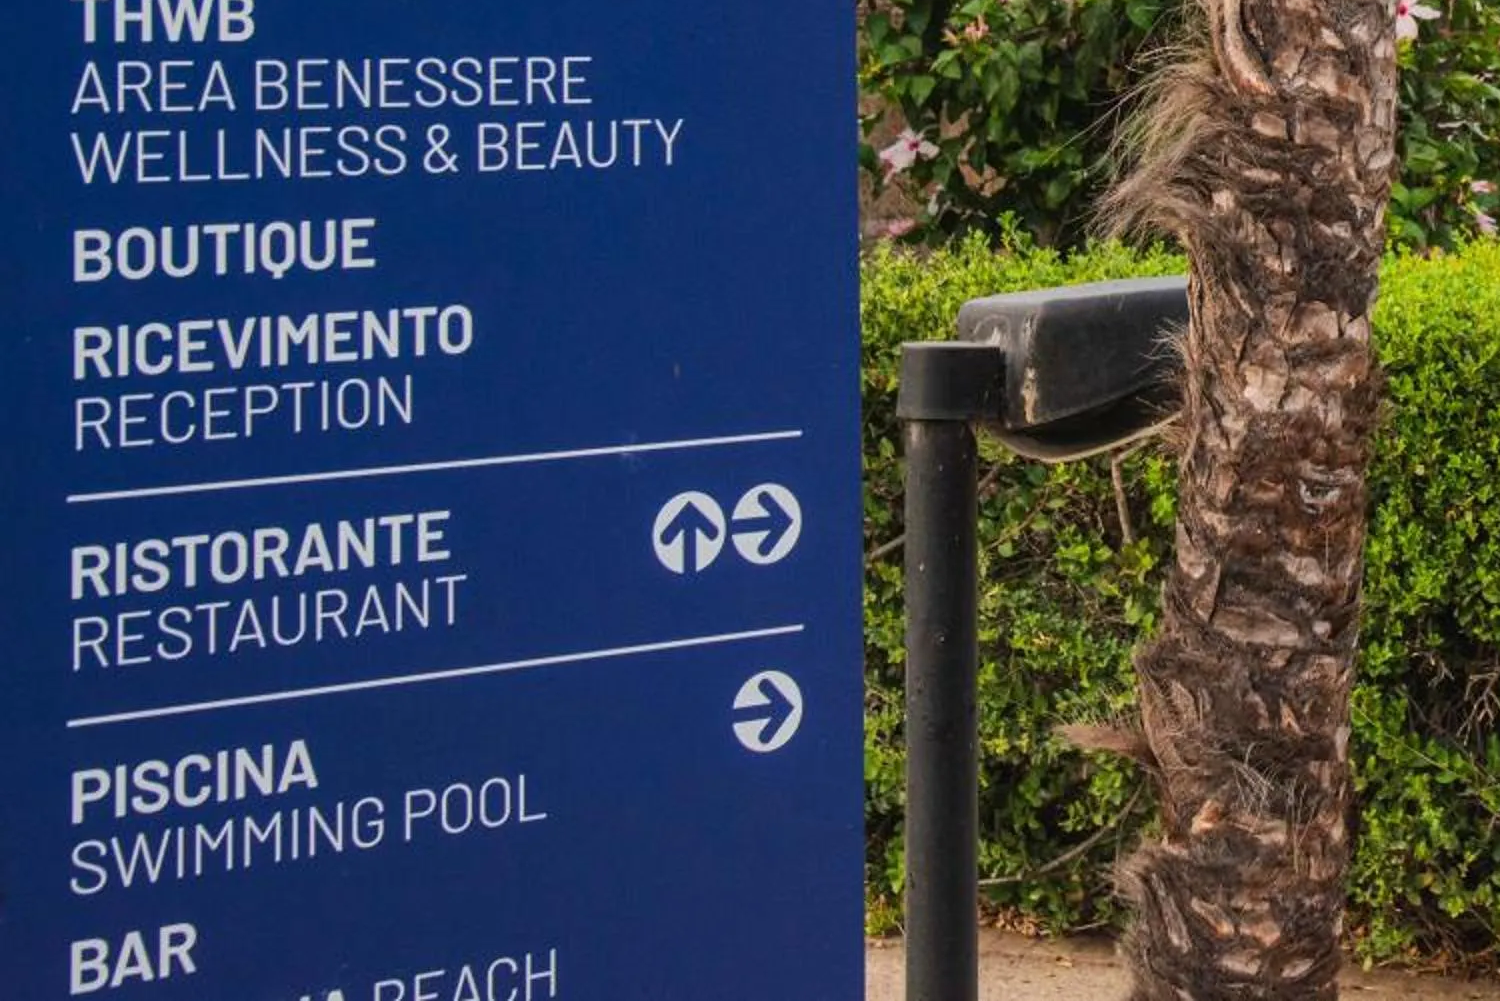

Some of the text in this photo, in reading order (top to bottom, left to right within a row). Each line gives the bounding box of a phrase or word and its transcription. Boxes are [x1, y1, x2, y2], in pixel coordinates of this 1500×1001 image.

[71, 56, 592, 114] AREA BENESSERE
[72, 118, 683, 183] WELLNESS & BEAUTY
[74, 218, 375, 282] BOUTIQUE
[74, 304, 473, 380] RICEVIMENTO
[76, 374, 412, 450] RECEPTION
[72, 510, 450, 599] RISTORANTE
[73, 574, 467, 671] RESTAURANT
[71, 739, 318, 824] PISCINA
[71, 774, 547, 895] SWIMMING POOL
[70, 923, 197, 995] BAR
